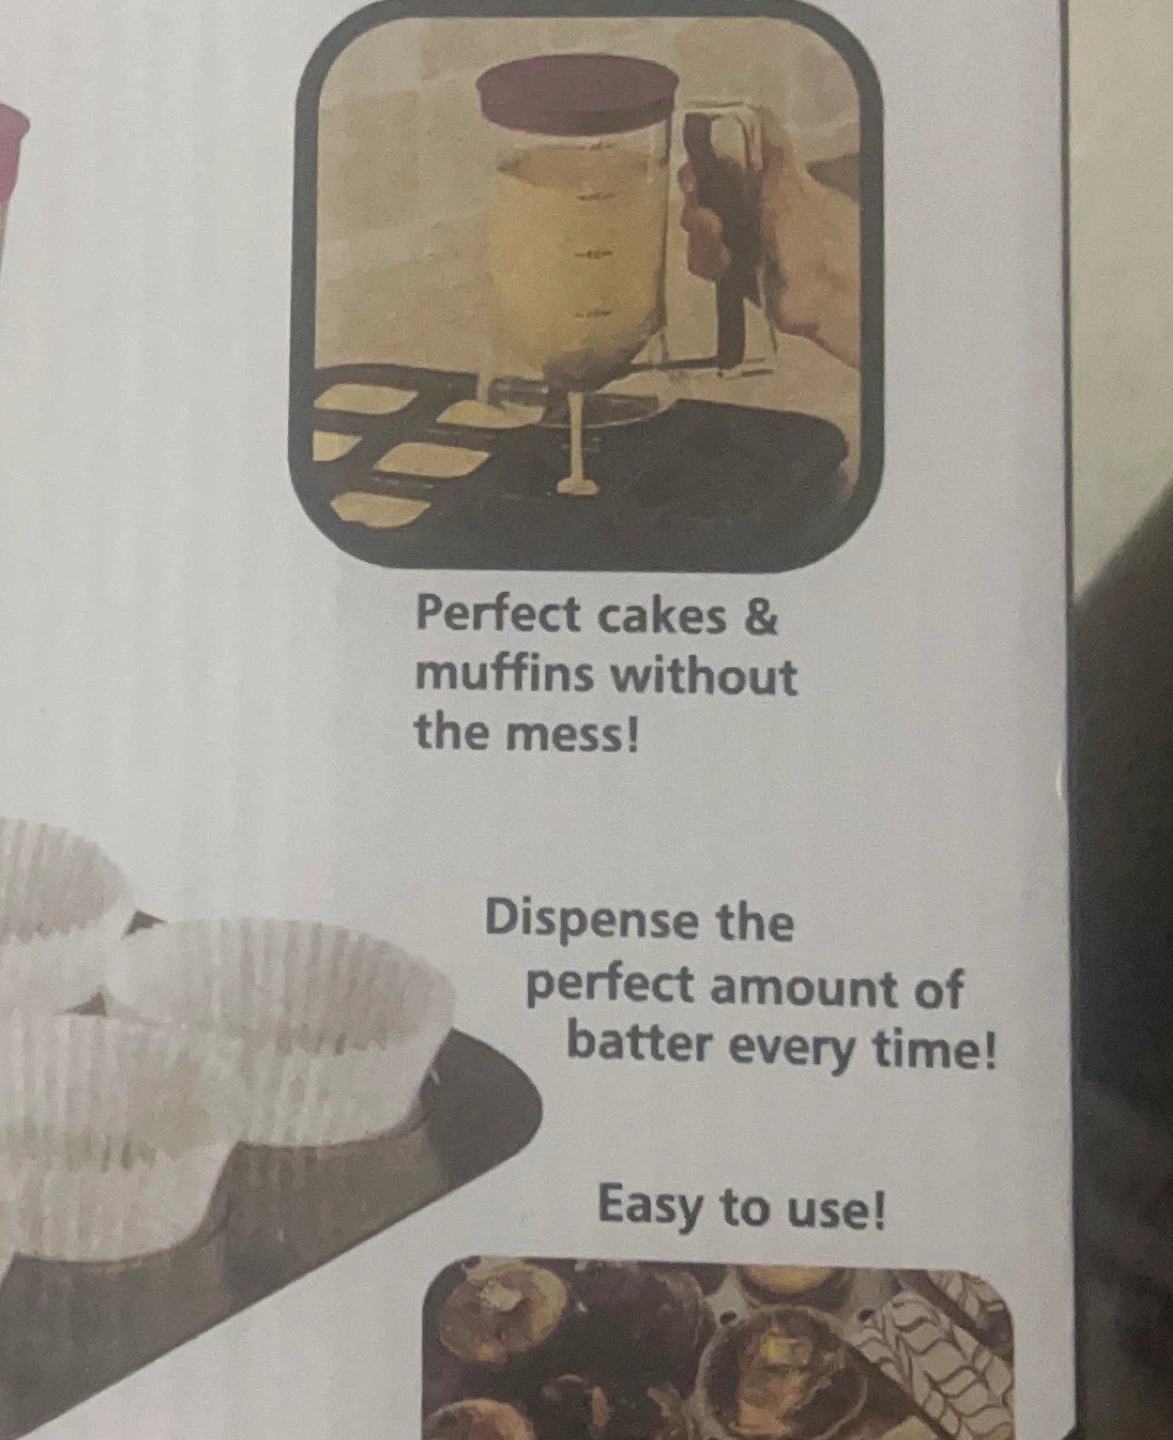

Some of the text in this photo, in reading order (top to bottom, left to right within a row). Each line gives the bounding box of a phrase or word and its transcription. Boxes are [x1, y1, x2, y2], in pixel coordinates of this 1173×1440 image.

[417, 590, 778, 636] Perfect cakes &
[416, 650, 799, 697] muffins without
[412, 709, 638, 753] the mess!
[486, 895, 795, 948] Dispense the
[527, 959, 965, 1010] perfect amount of
[567, 1016, 996, 1078] batter every time!
[599, 1182, 885, 1236] Easy to use!
